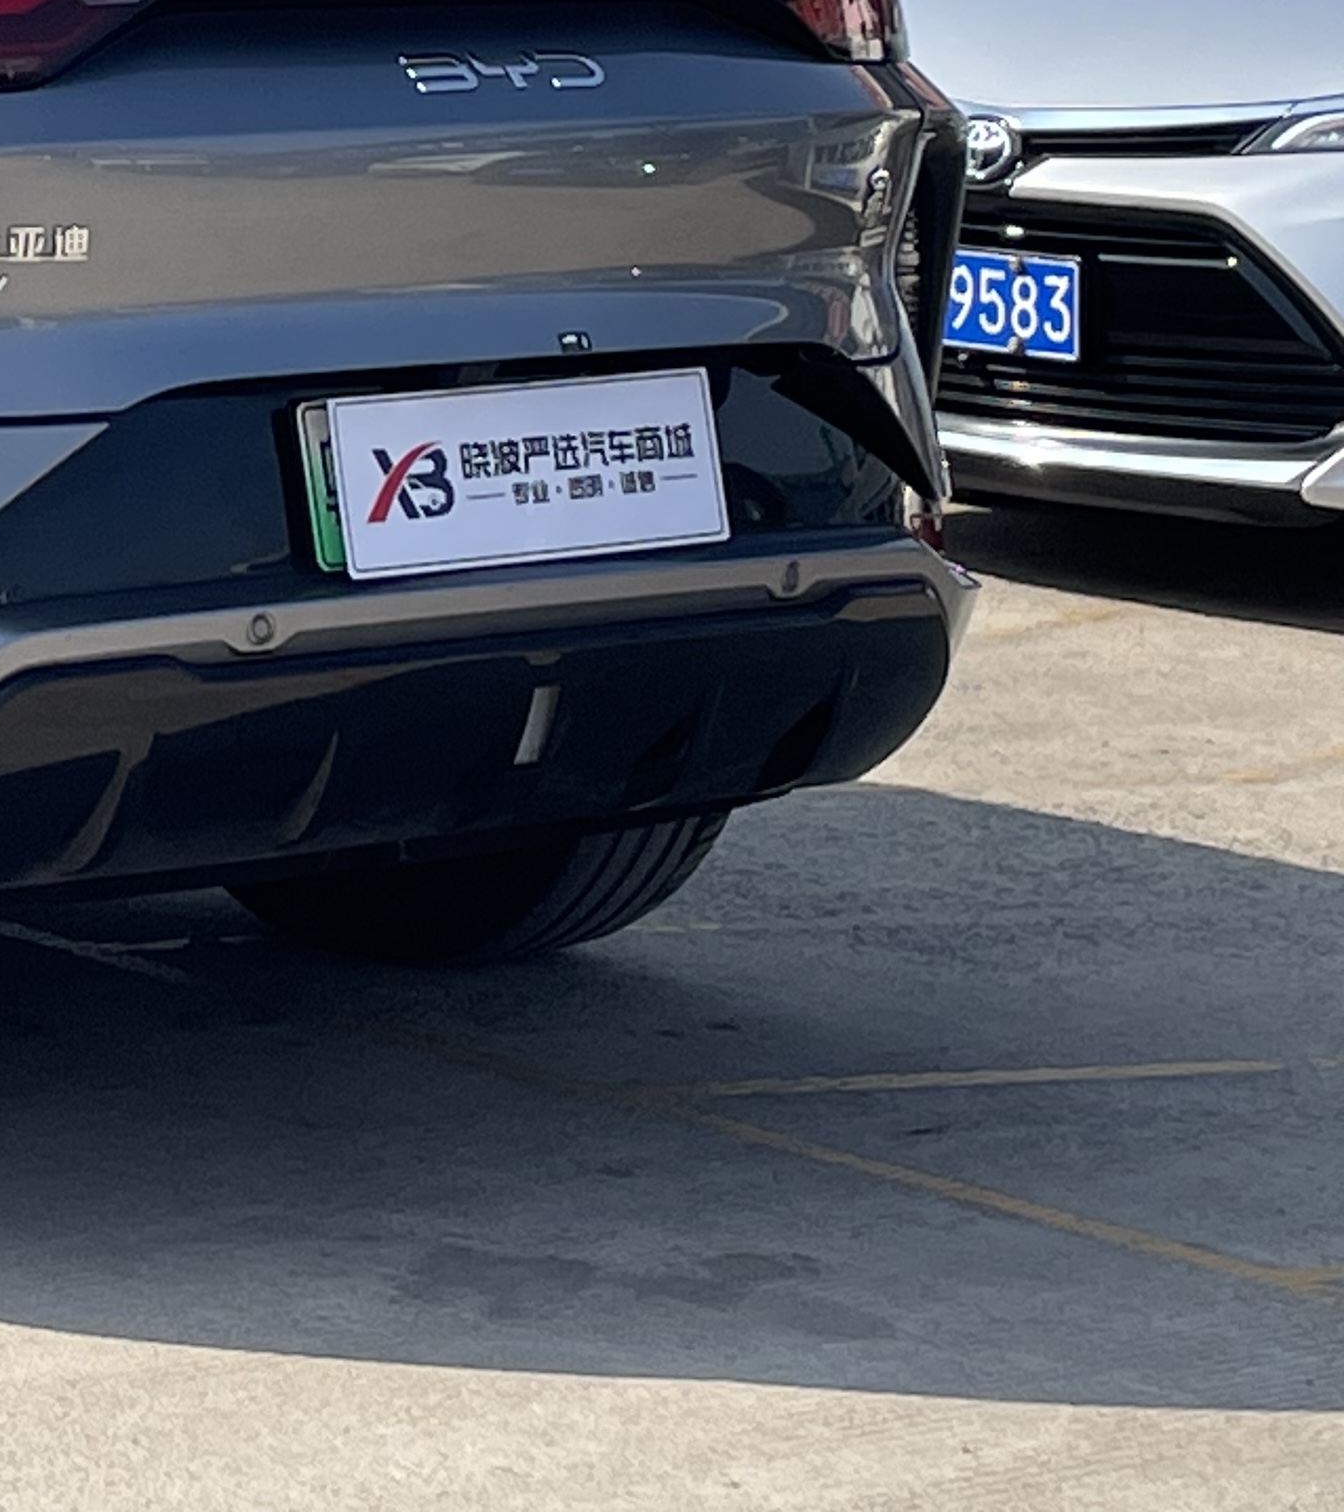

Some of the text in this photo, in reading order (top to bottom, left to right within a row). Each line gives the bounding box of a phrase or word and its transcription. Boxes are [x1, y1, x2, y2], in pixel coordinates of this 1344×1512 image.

[399, 50, 605, 93] BYD
[949, 265, 1072, 342] 9583
[459, 423, 695, 480] 晓波严选汽车商城
